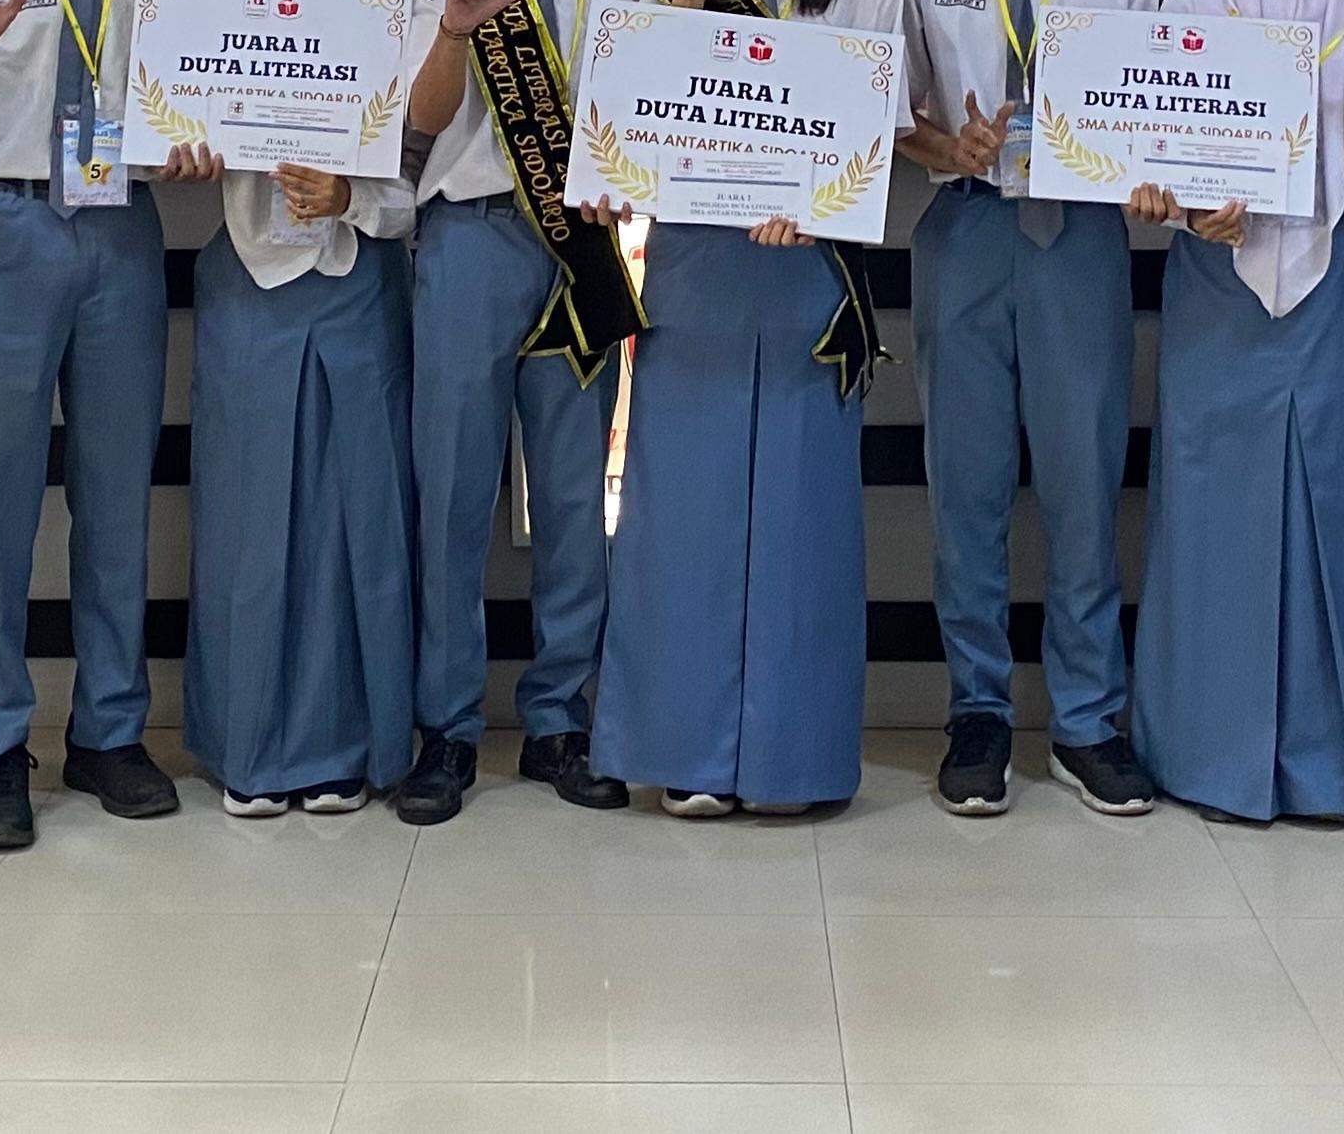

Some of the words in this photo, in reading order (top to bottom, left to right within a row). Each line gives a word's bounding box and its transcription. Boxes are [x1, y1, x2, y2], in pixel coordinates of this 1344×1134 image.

[220, 33, 298, 53] JUARA
[304, 38, 321, 54] II
[179, 56, 244, 76] DUTA
[249, 60, 358, 82] LITERASI
[1120, 67, 1200, 88] JUARA
[1206, 73, 1232, 90] III
[170, 83, 203, 98] SMA
[514, 46, 570, 152] LITERASI
[686, 76, 775, 104] JUARA
[781, 87, 791, 105] I
[1084, 90, 1150, 111] DUTA
[1155, 95, 1268, 118] LITERASI
[478, 18, 527, 125] TARTIKA
[513, 133, 571, 242] SIDOARJO
[634, 98, 707, 125] DUTA
[713, 107, 837, 140] LITERASI
[1076, 117, 1108, 131] SMA
[1111, 120, 1194, 135] ANTARTIKA
[625, 128, 660, 144] SMA
[663, 134, 754, 155] ANTARTIKA
[90, 163, 101, 179] 5
